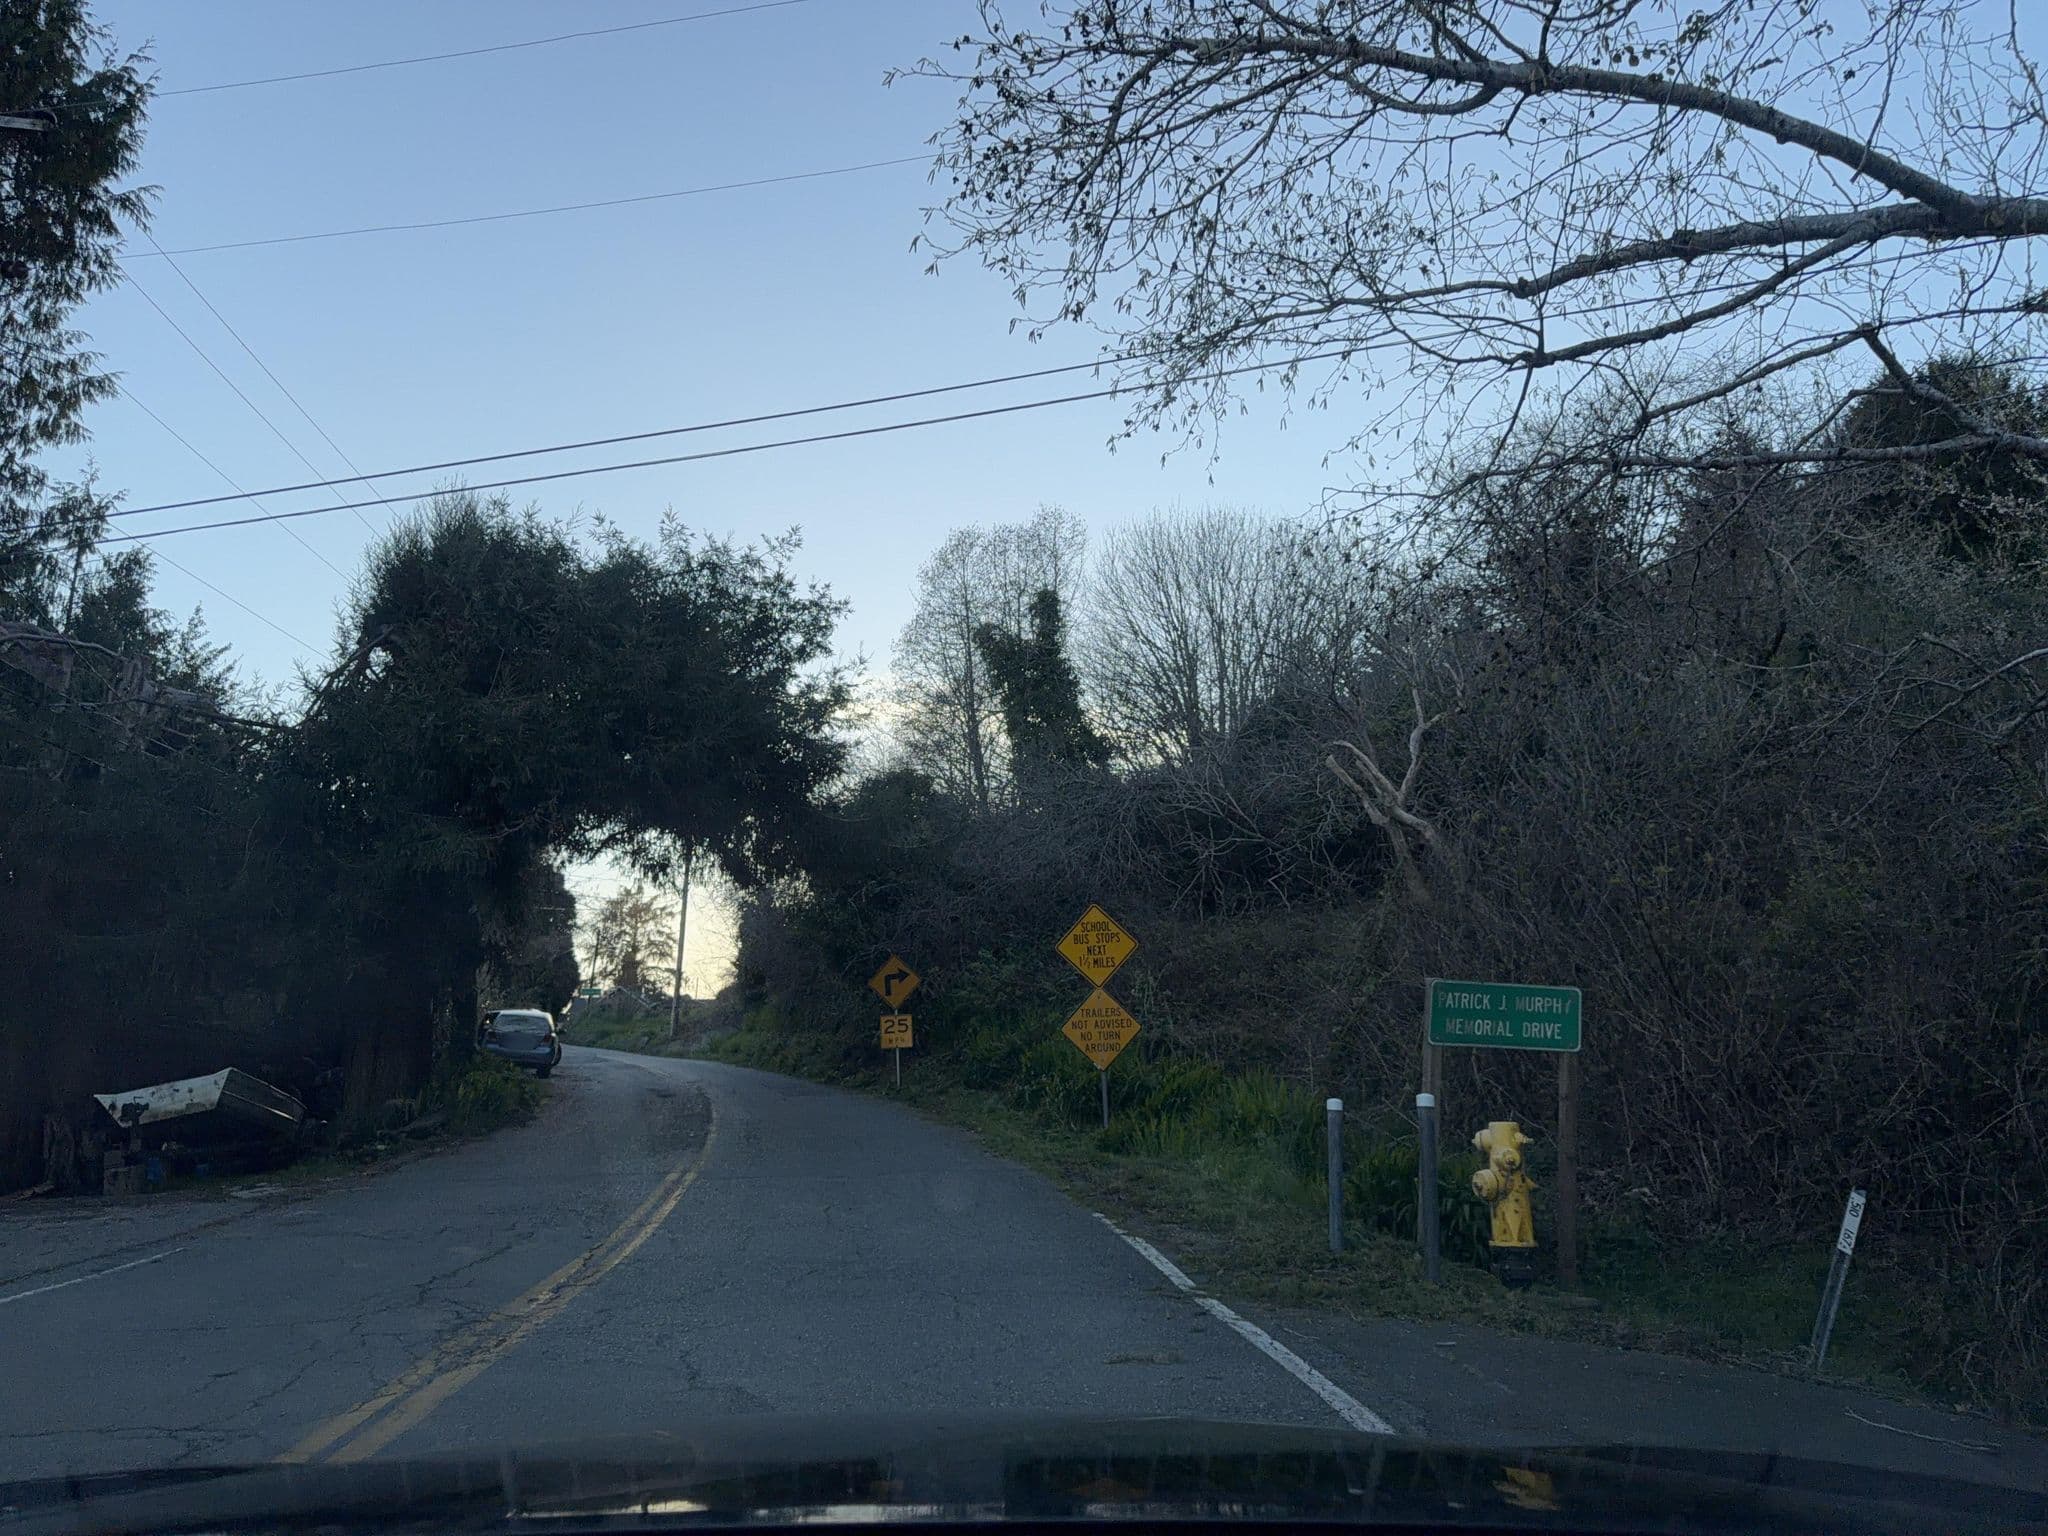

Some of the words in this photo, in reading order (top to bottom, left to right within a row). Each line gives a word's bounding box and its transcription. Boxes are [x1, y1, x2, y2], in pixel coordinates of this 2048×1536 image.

[1080, 921, 1111, 933] SCHOOL
[1073, 933, 1089, 945] BUS
[1095, 932, 1120, 944] STOPS
[1087, 945, 1106, 956] NEXT
[1093, 956, 1116, 968] MILES
[1438, 992, 1491, 1010] PATRICK
[1080, 1007, 1121, 1018] TRAILERS
[884, 1018, 909, 1034] 25
[1071, 1019, 1088, 1030] NOT
[1094, 1018, 1132, 1029] ADVISED
[1445, 1018, 1514, 1037] MEMORIAL
[1522, 1022, 1562, 1040] DRIVE
[1080, 1031, 1093, 1041] NO
[1098, 1030, 1121, 1041] TURN
[1085, 1042, 1121, 1053] AROUND
